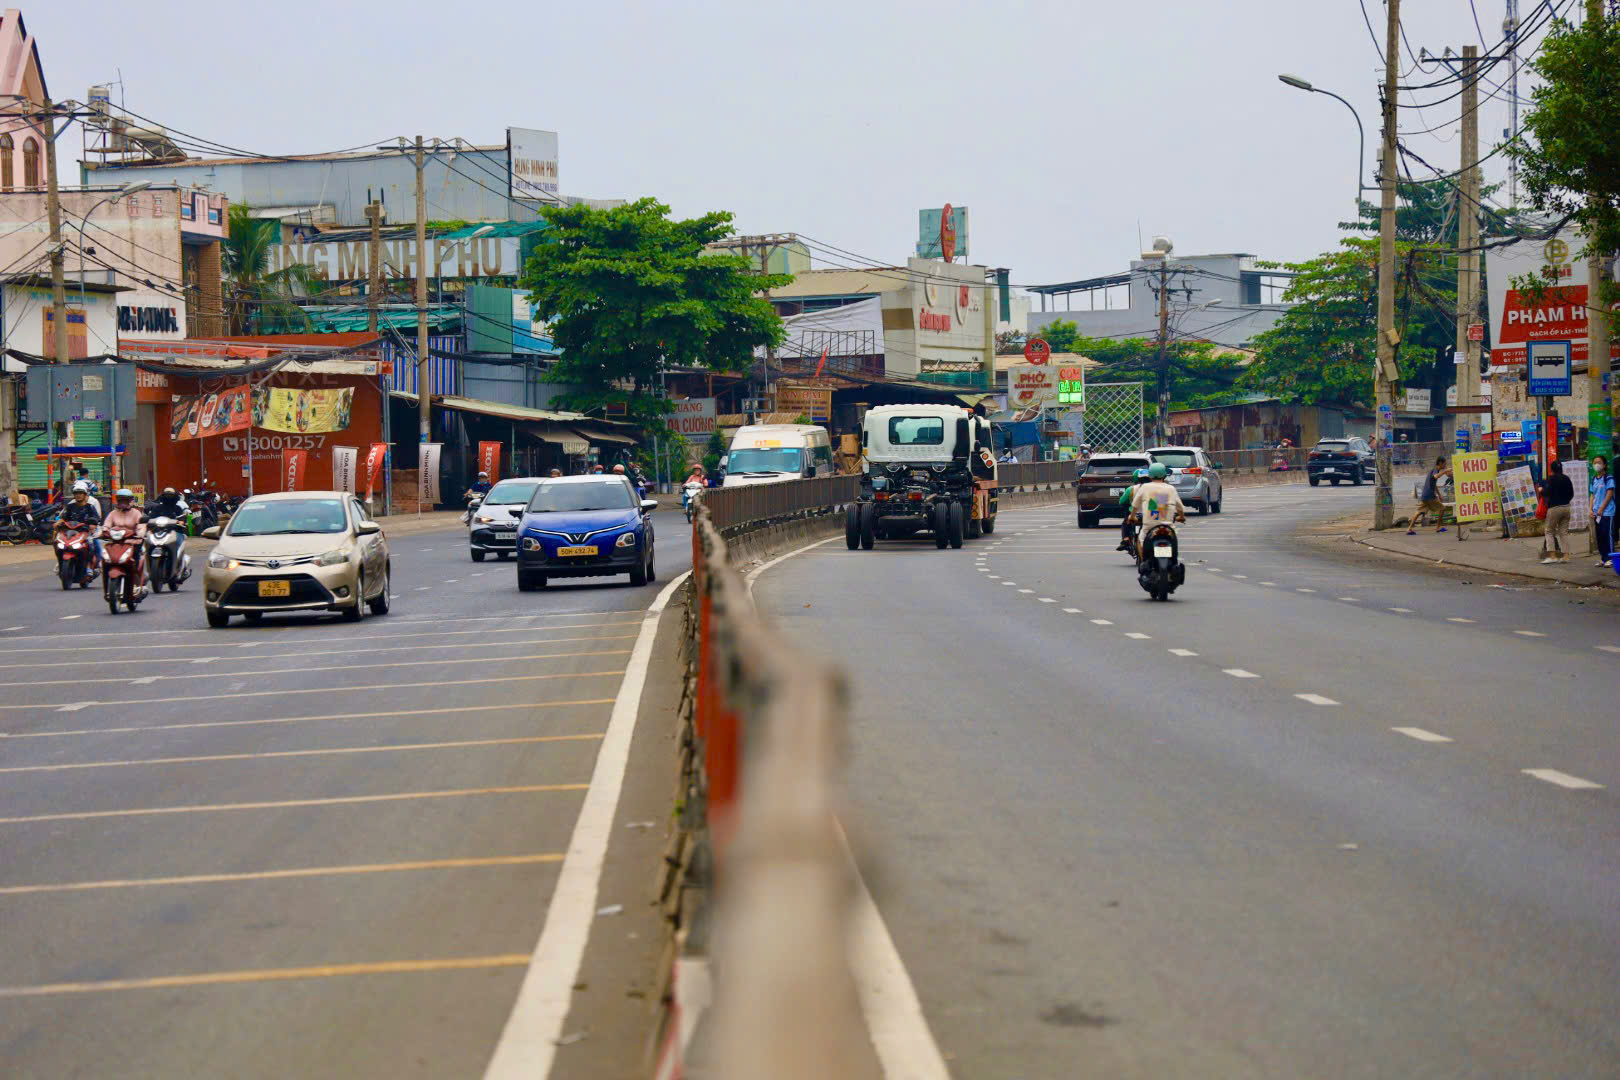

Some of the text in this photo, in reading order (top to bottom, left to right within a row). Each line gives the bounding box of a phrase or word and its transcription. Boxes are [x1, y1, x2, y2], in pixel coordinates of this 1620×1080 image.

[1507, 306, 1565, 328] PHẠM
[1020, 370, 1046, 383] PHỞ
[239, 435, 326, 451] 18001257
[1463, 459, 1487, 472] KHO
[1461, 480, 1494, 496] GẠCH
[1459, 497, 1499, 516] GIÁ RẺ
